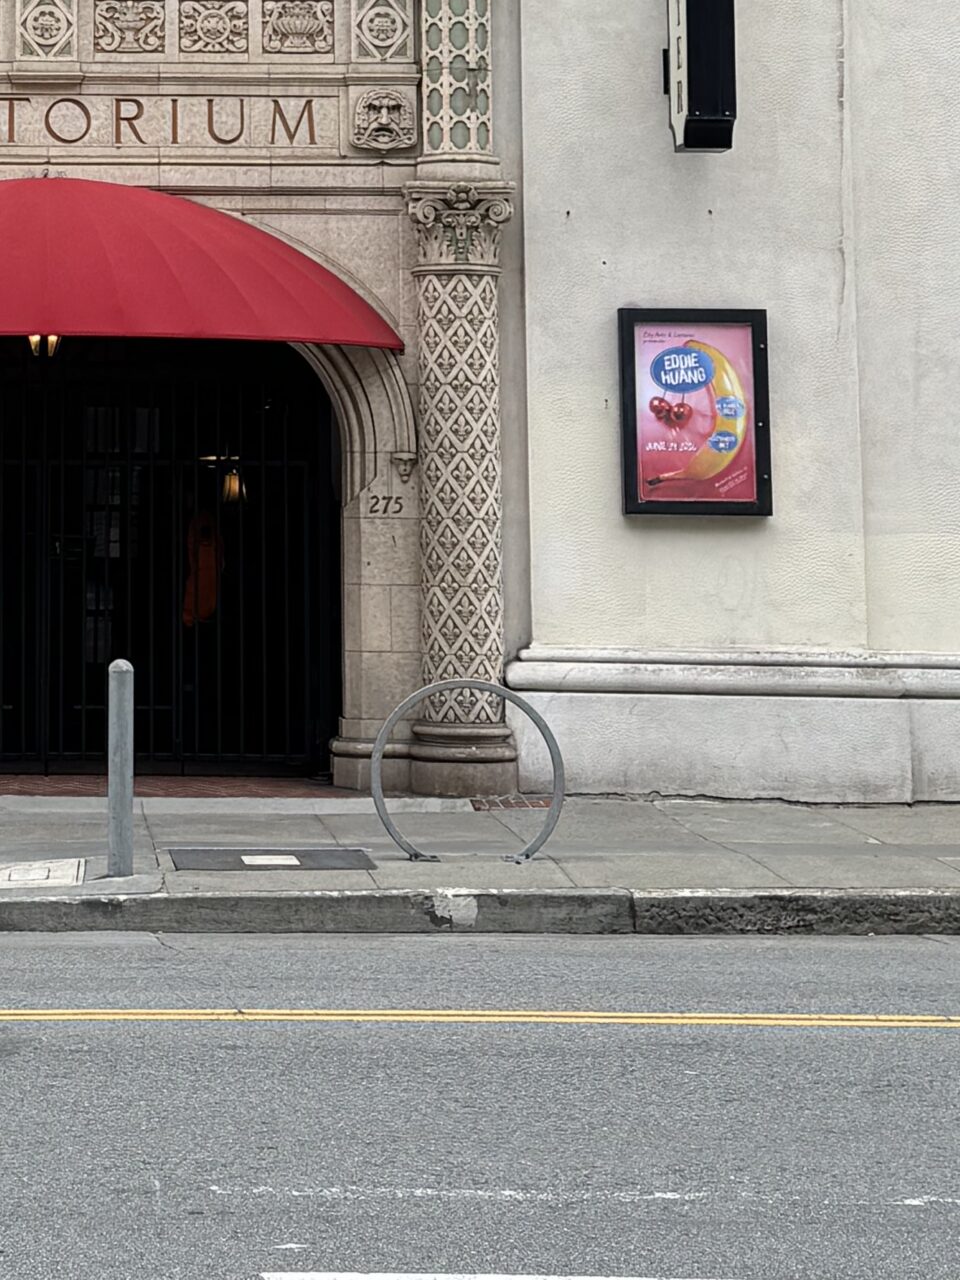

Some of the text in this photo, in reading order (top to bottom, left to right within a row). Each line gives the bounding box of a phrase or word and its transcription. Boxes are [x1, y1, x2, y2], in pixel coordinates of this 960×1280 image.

[664, 353, 699, 370] EDDIE
[660, 368, 706, 385] HUANG
[369, 495, 404, 515] 275
